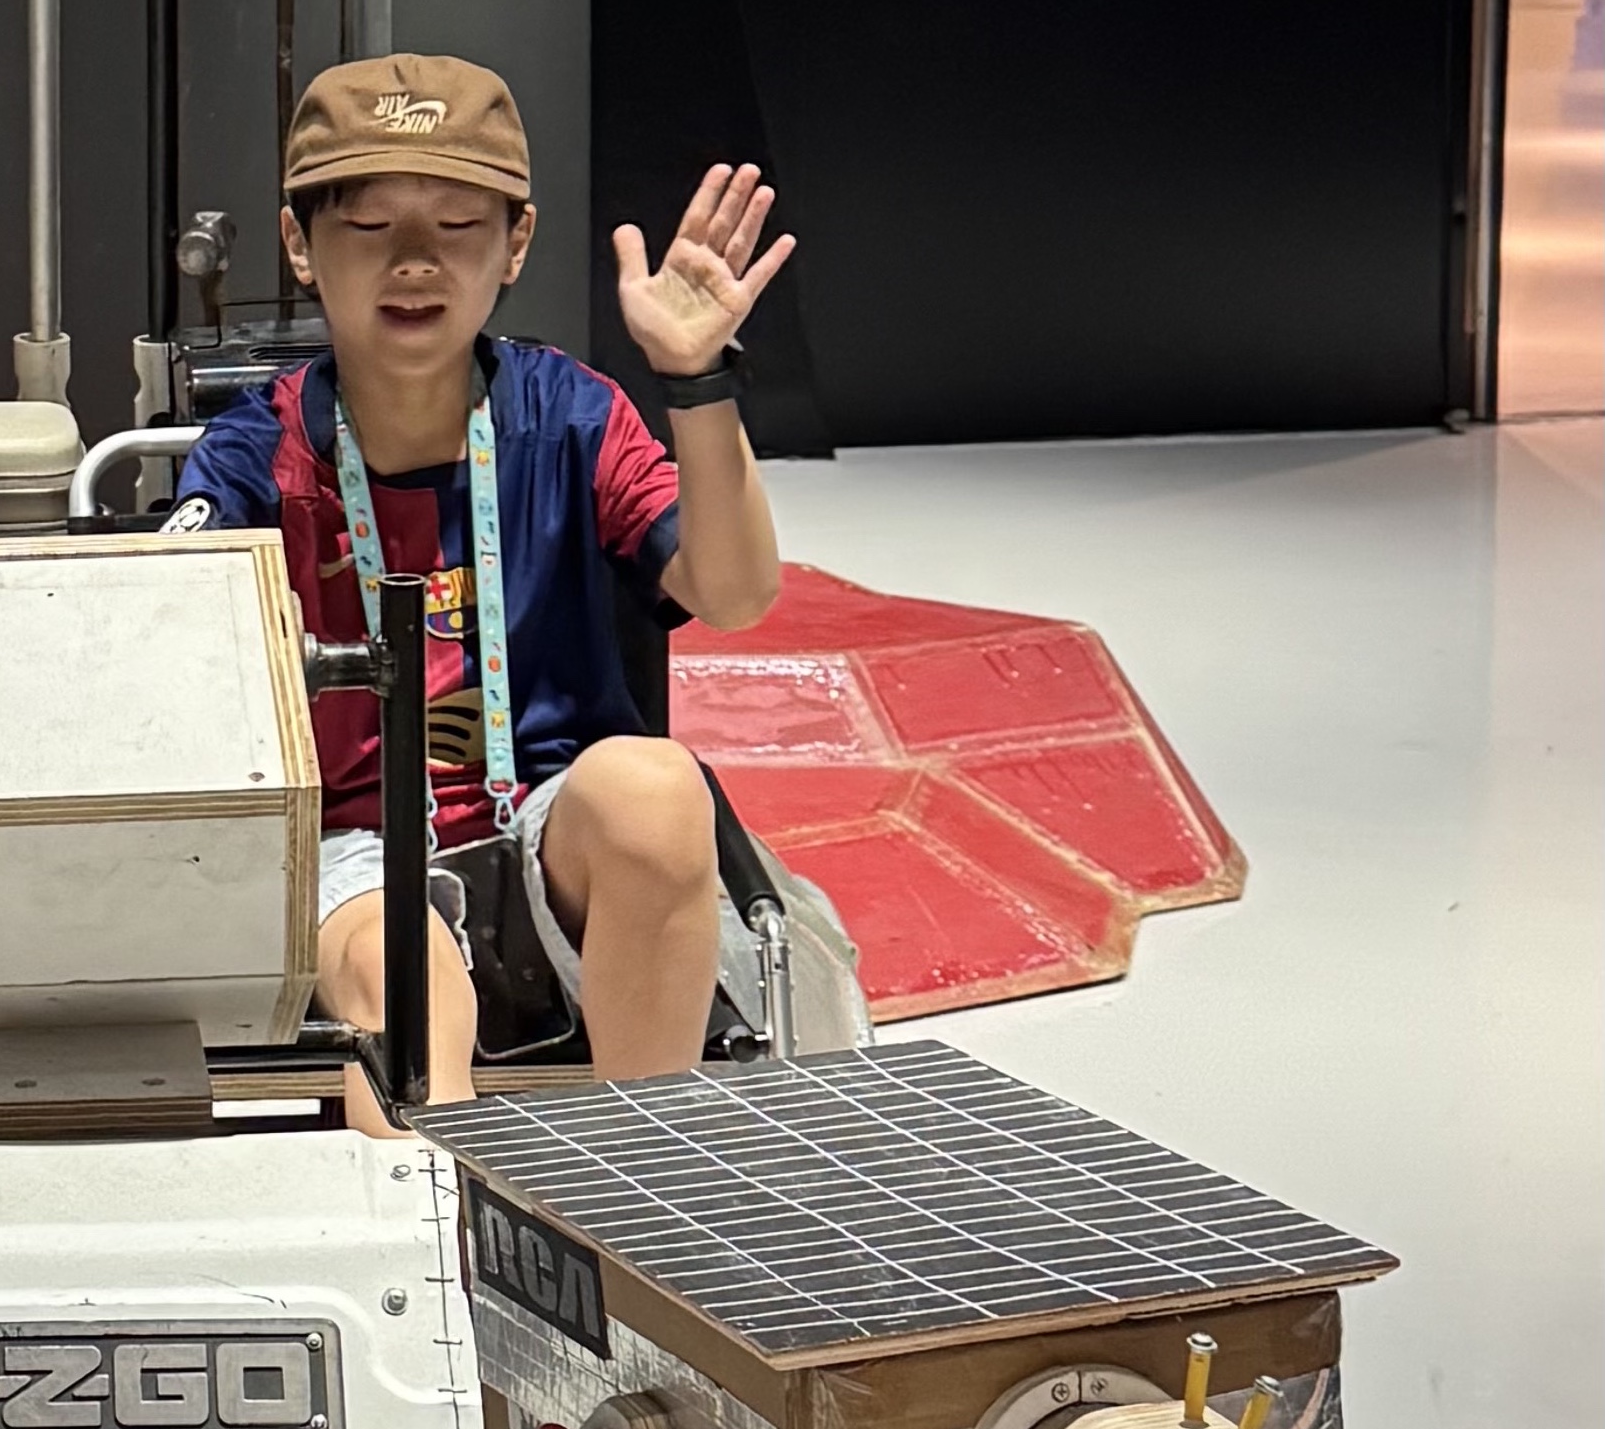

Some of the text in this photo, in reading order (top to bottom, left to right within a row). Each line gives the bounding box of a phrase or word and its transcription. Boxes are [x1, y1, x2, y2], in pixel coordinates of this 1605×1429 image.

[374, 94, 410, 116] AIR
[384, 112, 437, 133] NIKE
[478, 1196, 601, 1339] RCA
